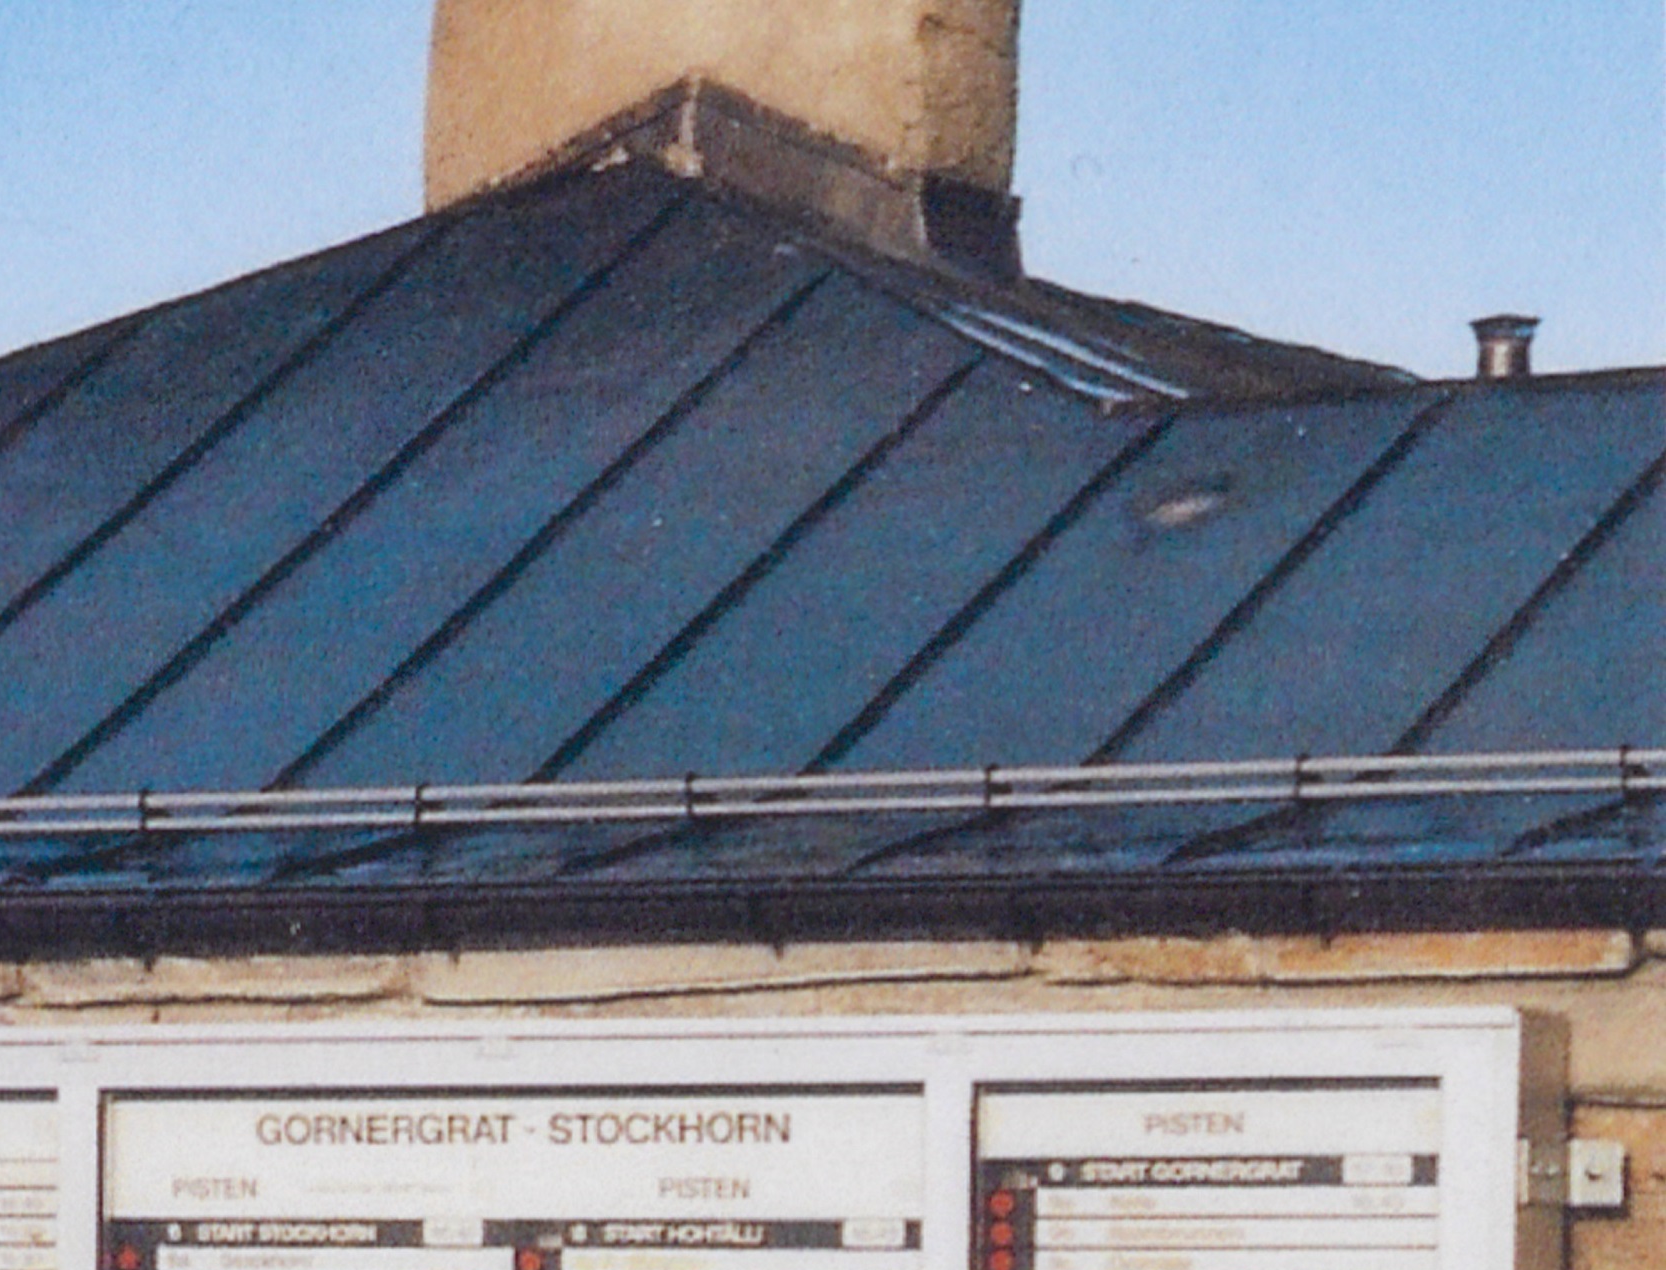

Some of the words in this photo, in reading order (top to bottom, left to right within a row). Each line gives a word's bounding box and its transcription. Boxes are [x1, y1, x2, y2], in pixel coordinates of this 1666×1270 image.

[256, 1112, 515, 1146] GORNERGRAT
[548, 1111, 792, 1145] STOCKHORN
[1144, 1111, 1245, 1135] PISTEN
[1080, 1161, 1149, 1182] START
[173, 1177, 258, 1200] PISTEN
[658, 1177, 751, 1199] PISTEN
